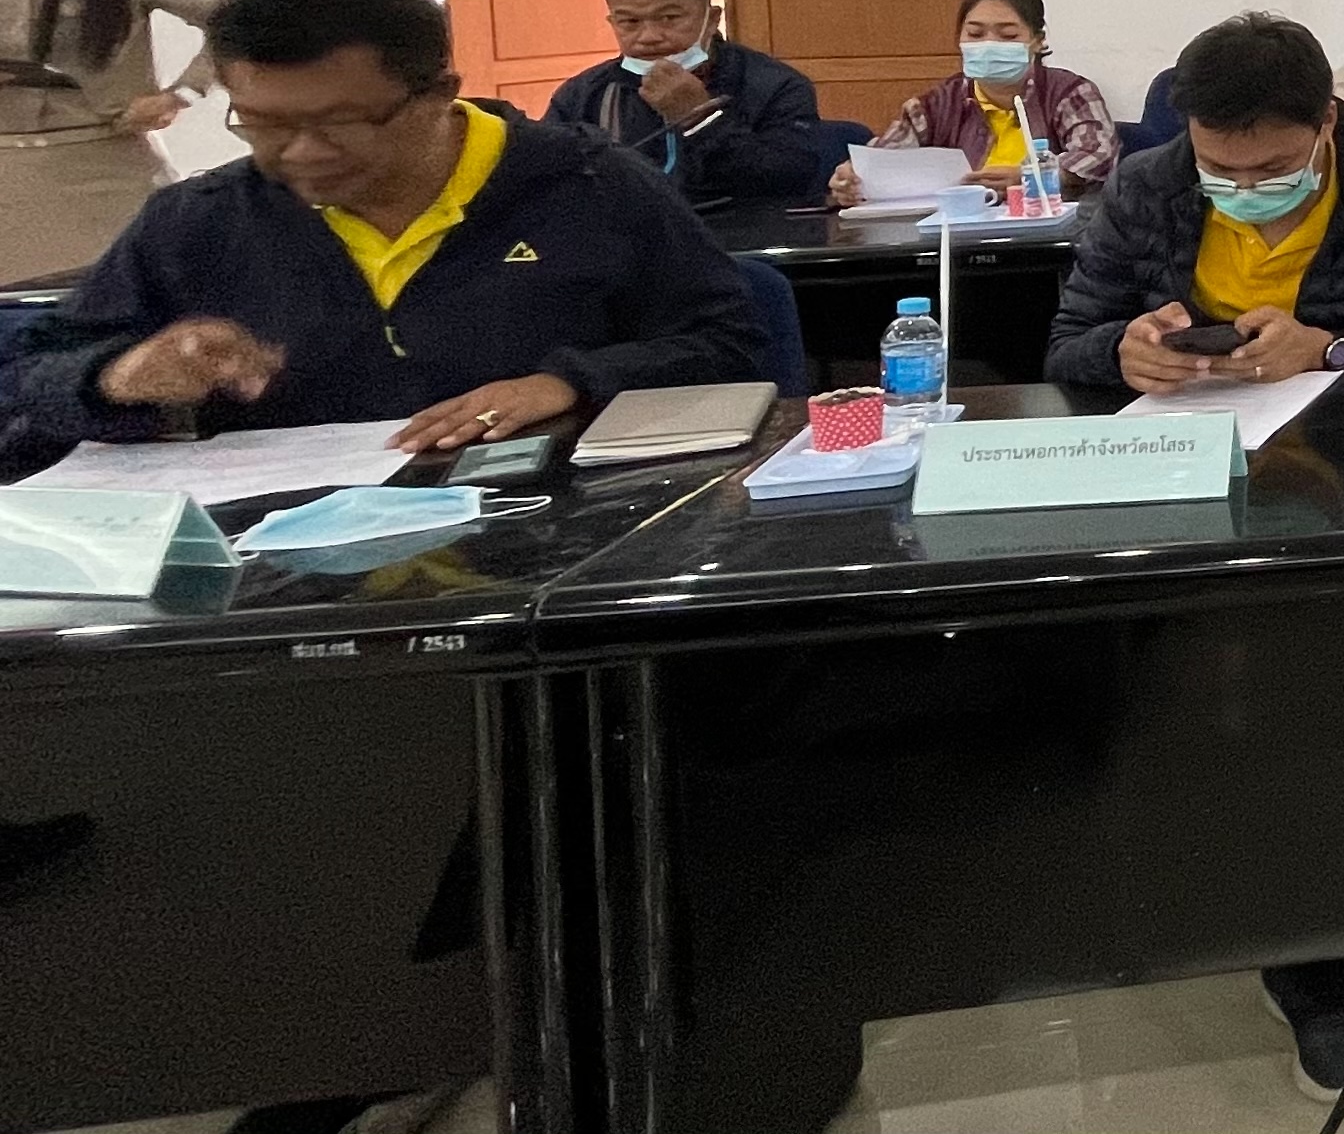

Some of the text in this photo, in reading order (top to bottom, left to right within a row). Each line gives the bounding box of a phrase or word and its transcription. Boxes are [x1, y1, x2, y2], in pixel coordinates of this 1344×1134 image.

[961, 434, 1197, 463] ประธานหอการค้าจังหวัดยโสธร
